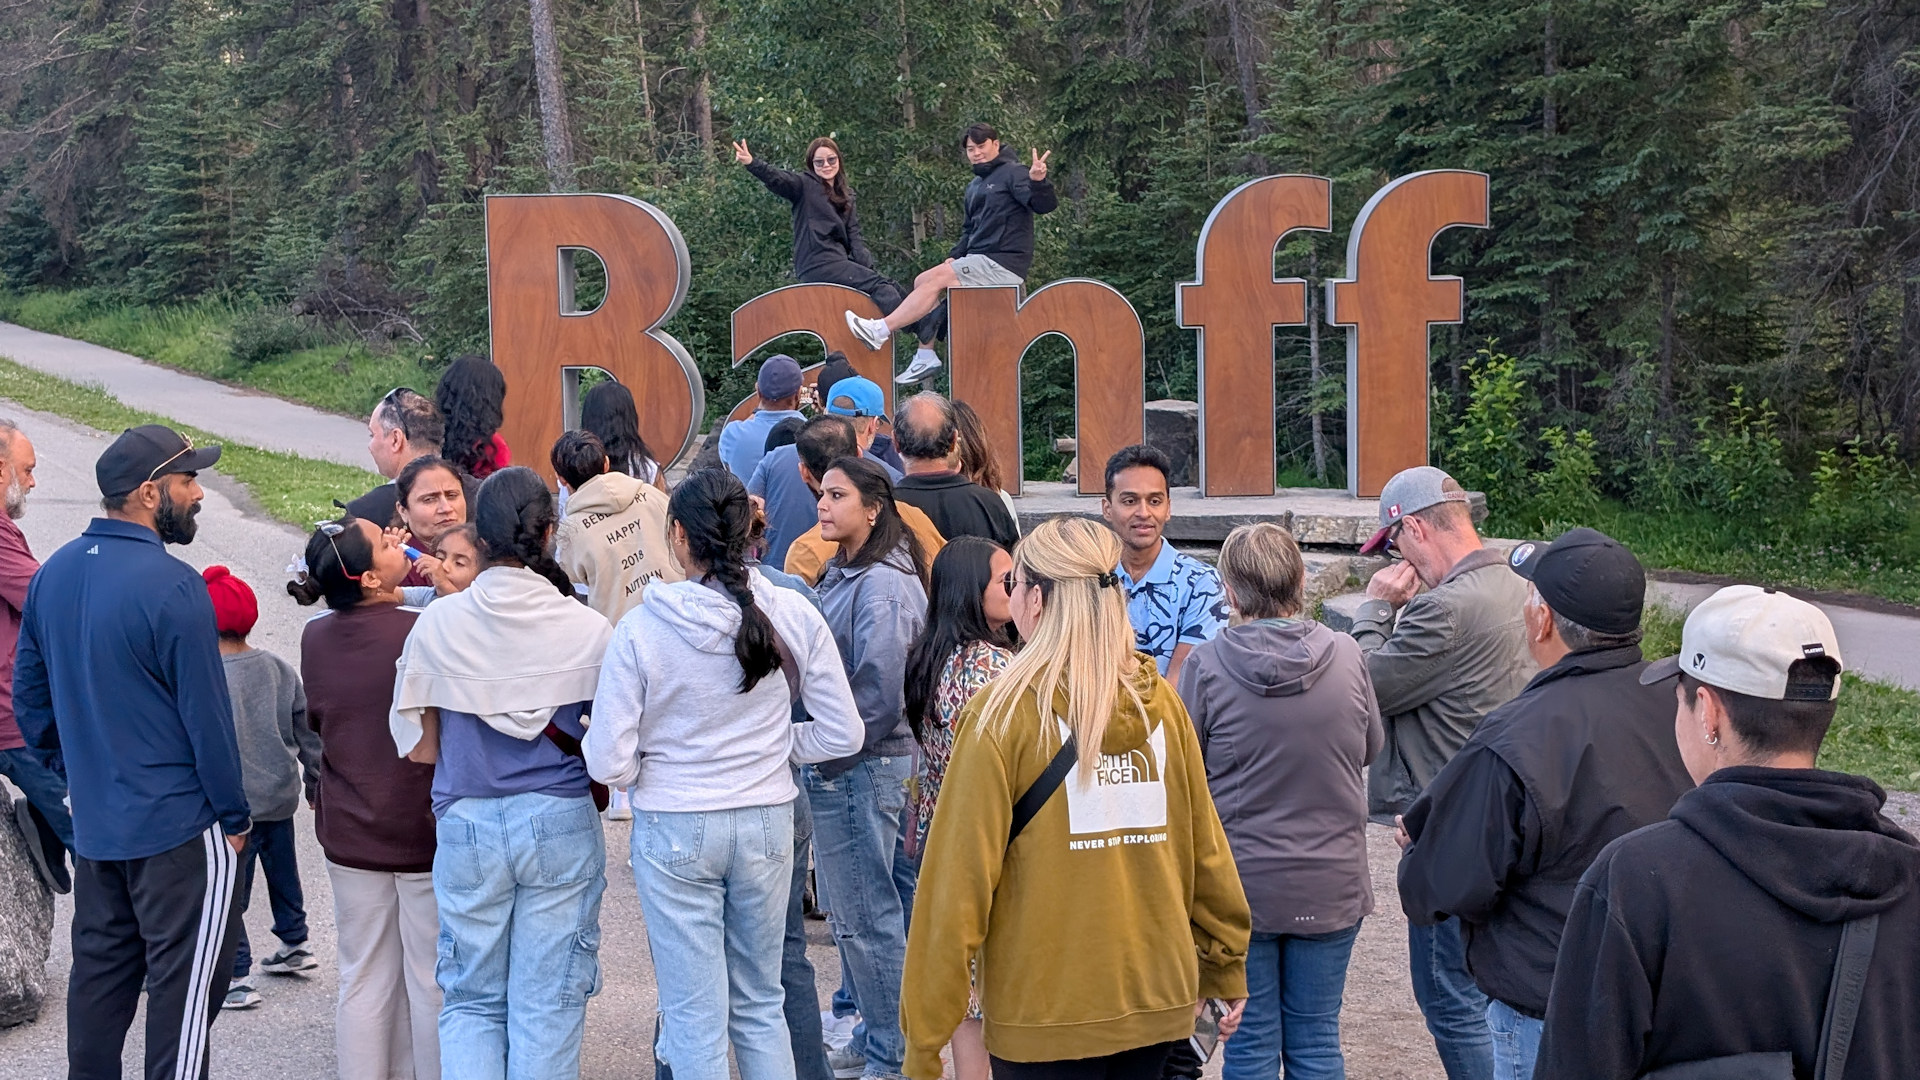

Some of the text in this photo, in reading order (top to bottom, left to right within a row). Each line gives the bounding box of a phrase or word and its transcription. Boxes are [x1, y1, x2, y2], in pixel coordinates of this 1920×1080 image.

[484, 169, 1490, 498] Banff
[606, 518, 641, 545] HAPPY
[621, 549, 645, 571] 2018
[1094, 754, 1130, 770] ORTH
[1096, 767, 1131, 787] FACE
[1069, 839, 1105, 851] NEVER
[1123, 832, 1168, 844] EXPLORING
